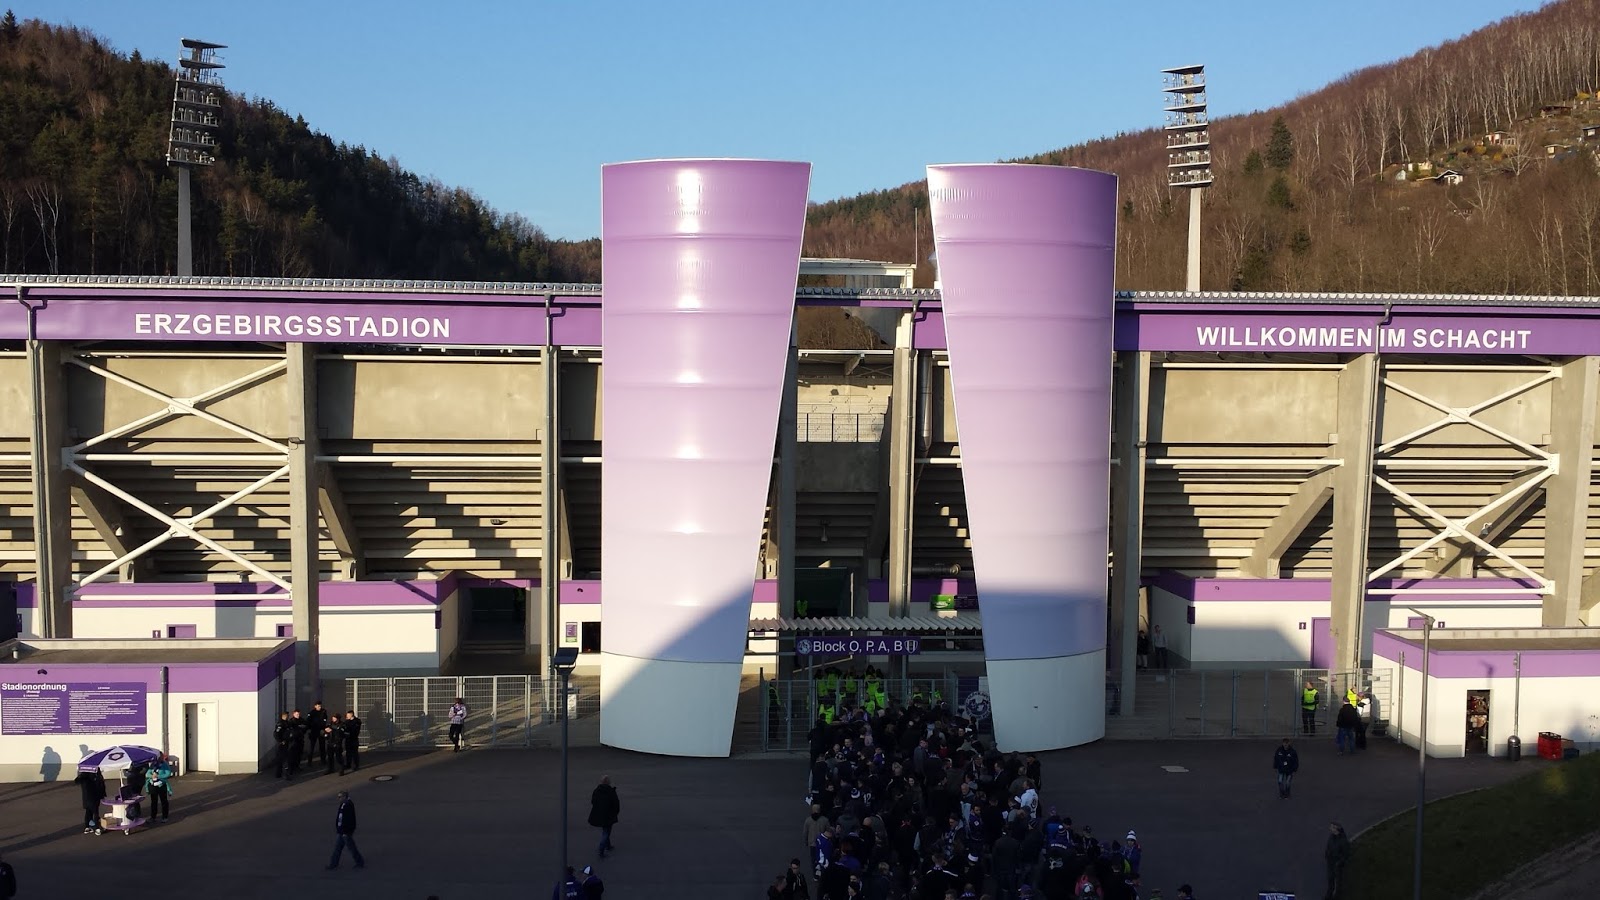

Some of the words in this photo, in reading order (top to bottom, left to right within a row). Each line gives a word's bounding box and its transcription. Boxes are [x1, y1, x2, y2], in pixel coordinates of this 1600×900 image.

[135, 313, 451, 338] ERZGEBIRGSSTADION
[1196, 326, 1371, 347] WILLKOMMEN
[1379, 328, 1406, 347] IM
[1412, 328, 1532, 349] SCHACHT
[813, 640, 846, 652] Block
[849, 640, 862, 653] O,
[866, 640, 875, 653] P,
[878, 640, 890, 653] A,
[894, 640, 903, 652] B
[1, 683, 67, 692] Stadionordnung
